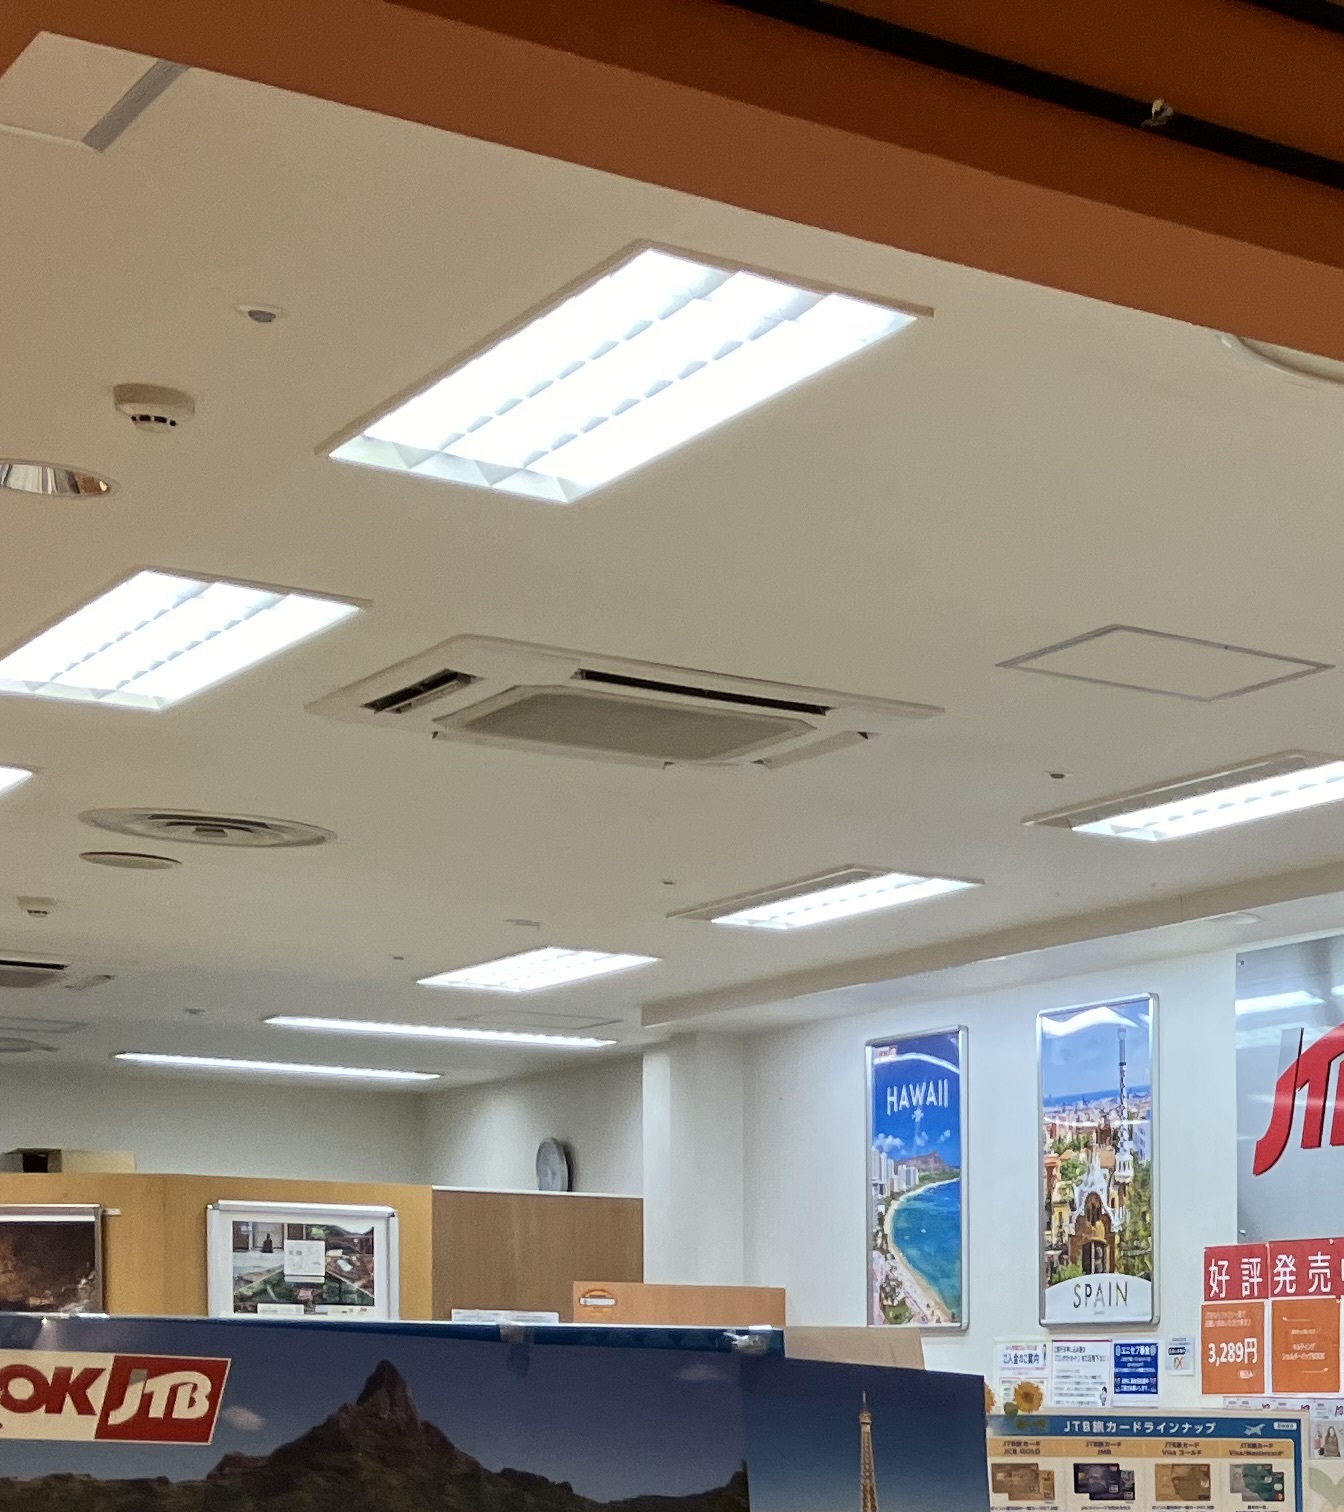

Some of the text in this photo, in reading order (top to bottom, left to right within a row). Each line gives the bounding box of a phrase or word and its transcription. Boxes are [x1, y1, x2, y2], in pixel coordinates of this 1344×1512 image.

[886, 1078, 949, 1116] HAWAII
[1072, 1281, 1130, 1310] SPAIN
[1208, 1338, 1258, 1365] 3,289円
[107, 1369, 212, 1424] JTB
[1064, 1421, 1217, 1437] JTB旅カードラインナップ
